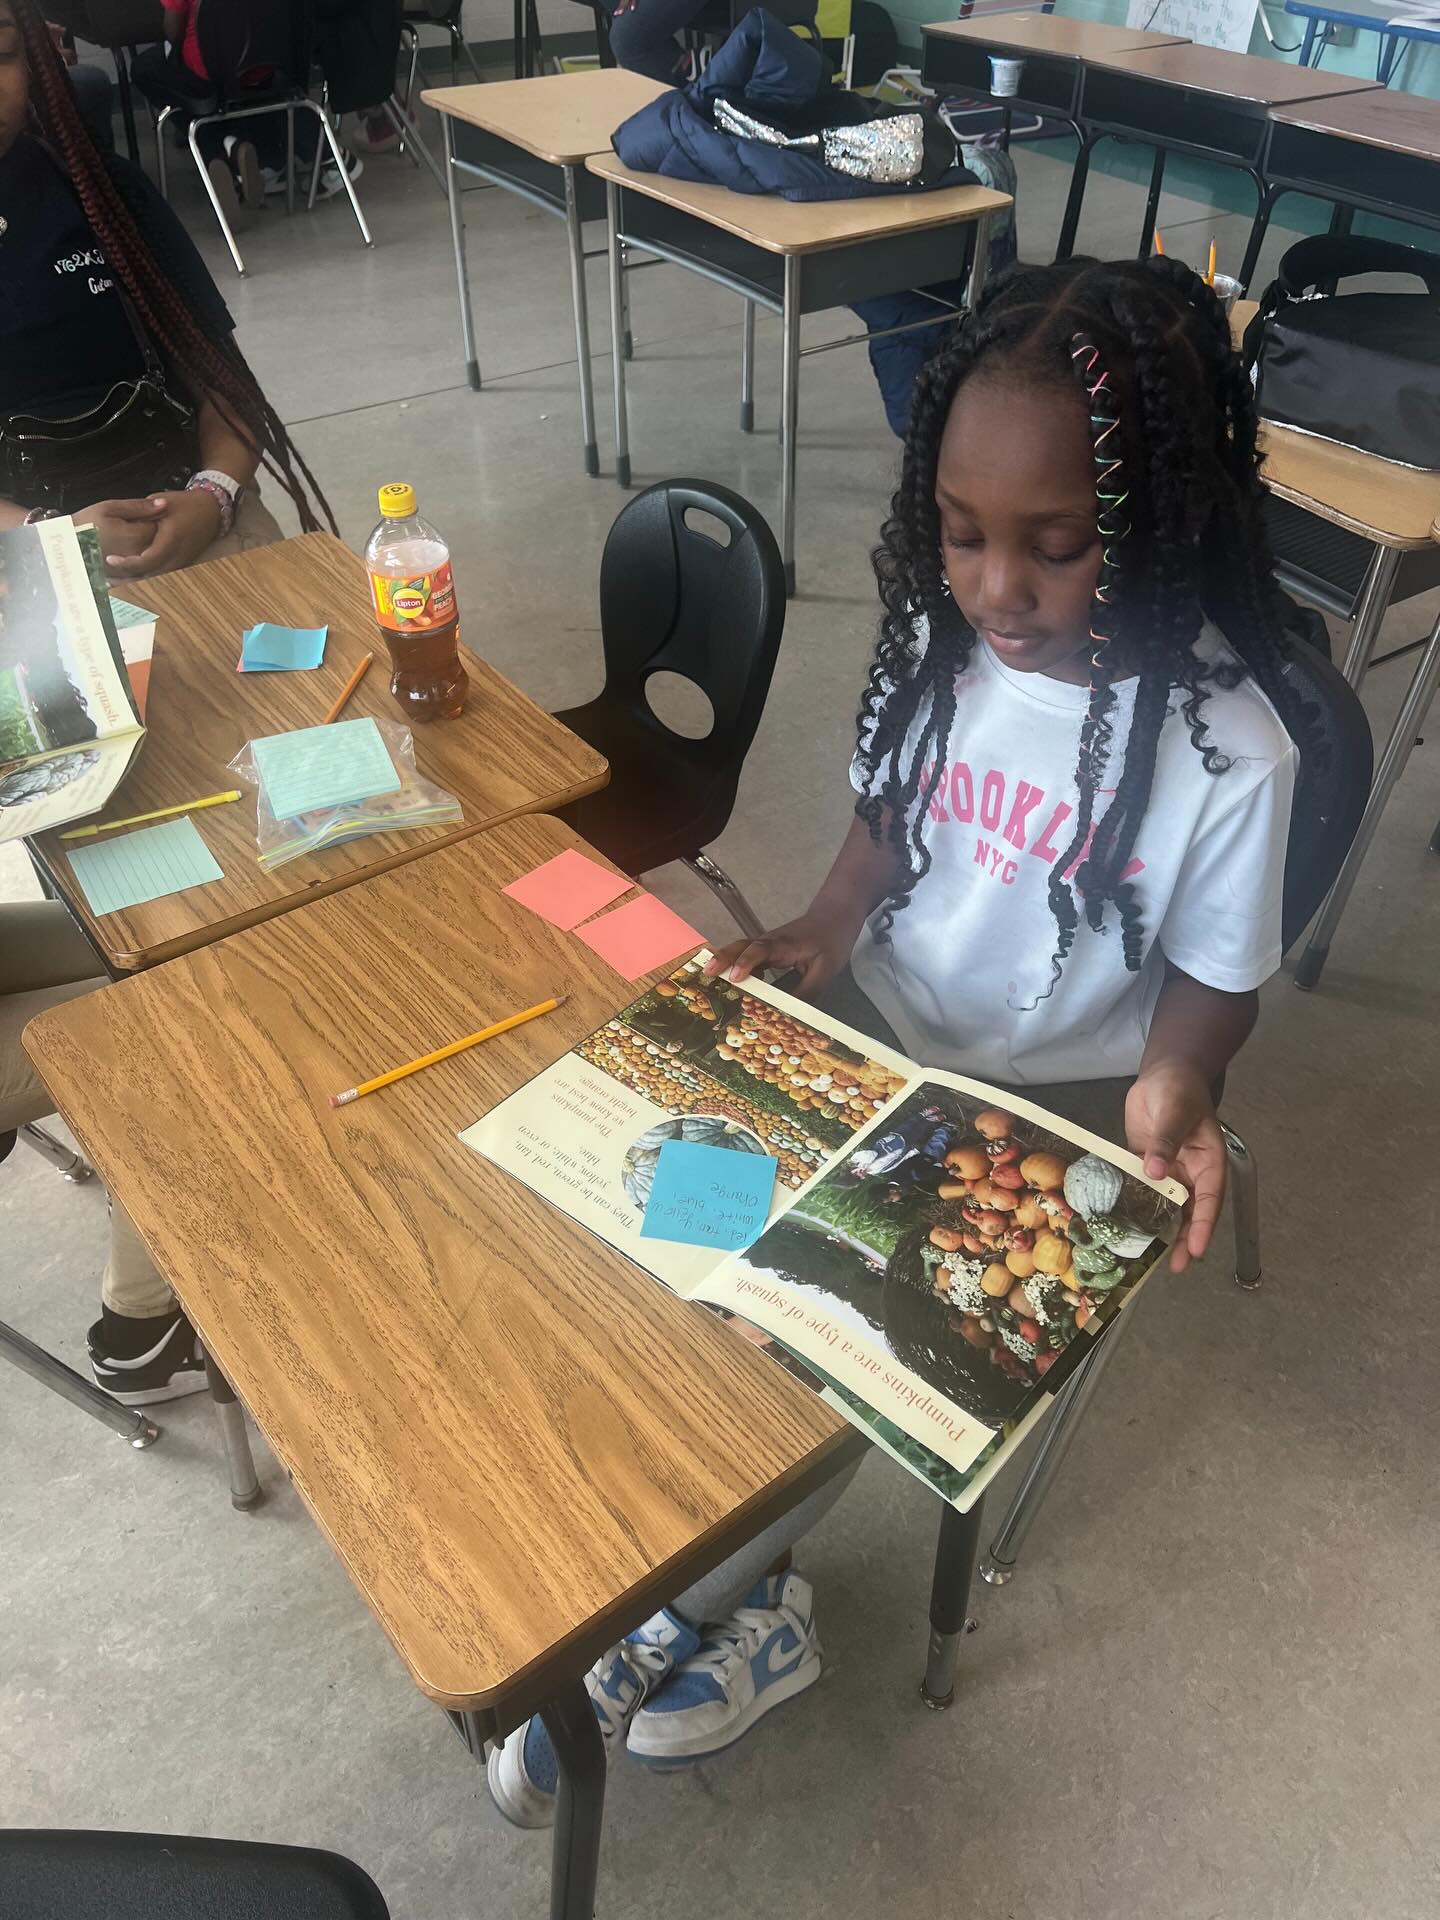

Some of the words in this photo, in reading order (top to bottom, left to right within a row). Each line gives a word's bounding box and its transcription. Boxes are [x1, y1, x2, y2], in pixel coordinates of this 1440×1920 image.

[396, 599, 421, 608] Lipton
[88, 663, 100, 679] of
[919, 760, 1147, 897] ROOKL
[973, 838, 1018, 886] NYC
[554, 1078, 570, 1089] are
[568, 1087, 589, 1103] best
[551, 1094, 596, 1126] pumpkins
[589, 1100, 612, 1118] know
[608, 1096, 638, 1118] bright
[594, 1121, 613, 1138] The
[611, 1116, 625, 1127] we
[518, 1125, 540, 1141] even
[539, 1138, 551, 1148] or
[552, 1147, 578, 1169] white,
[579, 1146, 601, 1165] blue.
[553, 1167, 581, 1190] green,
[580, 1165, 612, 1189] yellow,
[579, 1186, 593, 1200] be
[593, 1195, 611, 1209] can
[611, 1208, 635, 1229] They
[736, 1277, 788, 1312] squash.
[783, 1303, 805, 1321] of
[806, 1317, 840, 1346] type
[841, 1341, 853, 1353] a
[854, 1350, 882, 1374] are
[882, 1371, 967, 1442] Pumpkins
